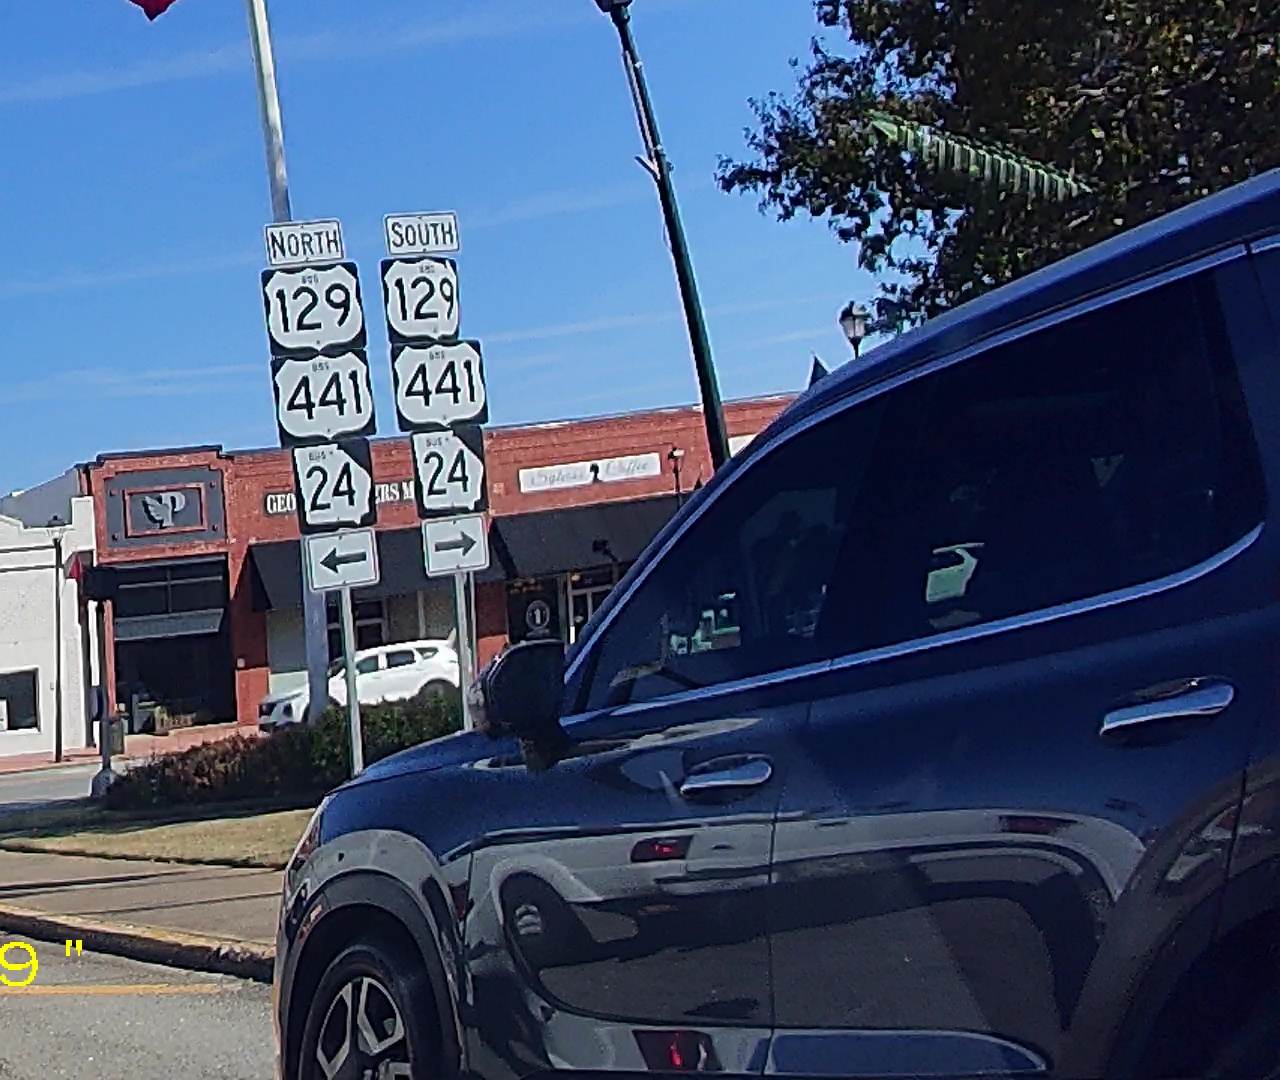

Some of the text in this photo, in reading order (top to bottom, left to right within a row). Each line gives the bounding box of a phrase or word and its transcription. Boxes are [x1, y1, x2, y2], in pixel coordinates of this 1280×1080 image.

[270, 230, 340, 259] NORTH
[391, 222, 454, 247] SOUTH
[275, 282, 351, 332] 129
[394, 275, 455, 321] 129
[286, 369, 363, 420] 441
[404, 359, 477, 407] 441
[306, 461, 357, 512] 24
[423, 449, 470, 497] 24
